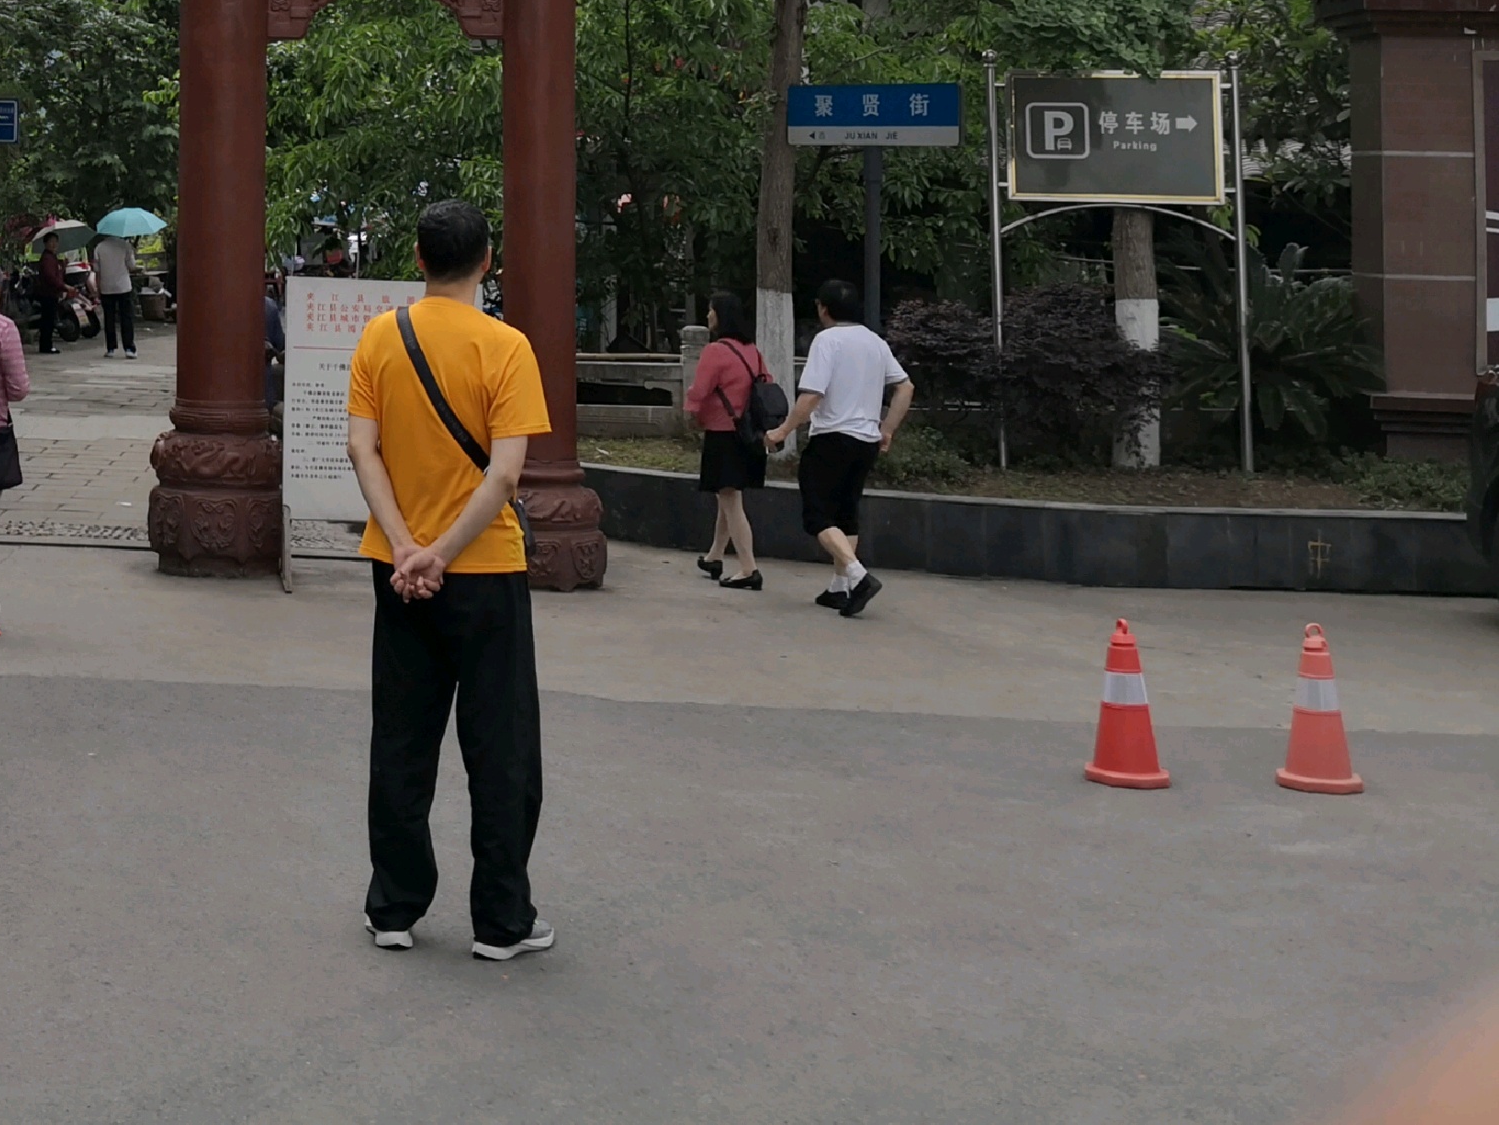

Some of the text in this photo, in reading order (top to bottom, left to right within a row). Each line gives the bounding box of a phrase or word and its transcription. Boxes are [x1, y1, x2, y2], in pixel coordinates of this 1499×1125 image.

[813, 92, 931, 117] 聚贤街
[885, 130, 899, 141] JIE
[1043, 110, 1074, 151] P
[1098, 110, 1171, 136] 停车场
[1112, 139, 1158, 152] Parking
